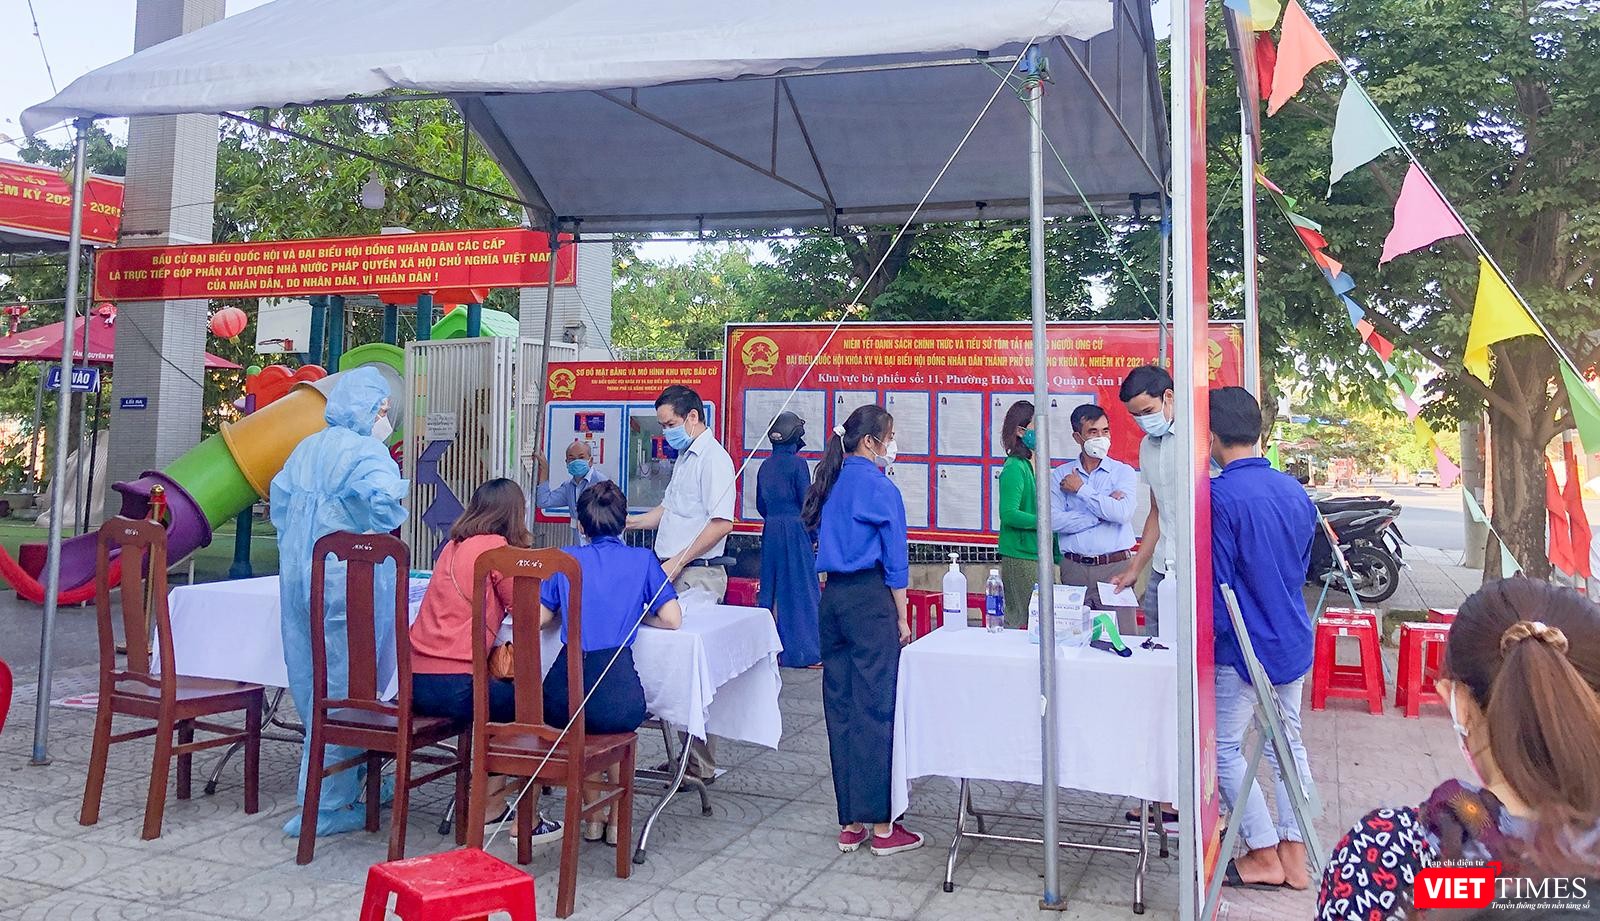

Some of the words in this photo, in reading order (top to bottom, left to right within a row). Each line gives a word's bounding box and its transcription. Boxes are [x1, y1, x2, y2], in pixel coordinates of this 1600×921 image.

[45, 192, 72, 206] 202
[152, 252, 171, 266] BẦU
[174, 251, 188, 264] CỬ
[190, 251, 207, 265] ĐẠI
[209, 250, 231, 263] BIỂU
[234, 249, 260, 263] QUỐC
[263, 249, 280, 263] HỘI
[282, 248, 295, 260] VÀ
[298, 247, 316, 261] ĐẠI
[319, 245, 342, 258] BIỂU
[345, 244, 362, 258] HỘI
[365, 242, 394, 256] ĐỒNG
[398, 240, 428, 254] NHÂN
[431, 240, 455, 252] DÂN
[457, 239, 480, 251] CÁC
[483, 238, 505, 250] CẤP
[110, 269, 121, 281] LÀ
[124, 268, 147, 281] TRỰC
[150, 266, 171, 279] TIẾP
[173, 266, 192, 279] GÓP
[195, 265, 222, 278] PHẦN
[225, 264, 243, 276] XÂY
[247, 263, 273, 277] DỰNG
[277, 262, 297, 274] NHÀ
[300, 261, 328, 273] NƯỚC
[332, 260, 359, 272] PHÁP
[362, 257, 397, 271] QUYỀN
[400, 256, 414, 269] XÃ
[417, 256, 436, 269] HỘI
[439, 254, 461, 267] CHỦ
[464, 253, 499, 265] NGHĨA
[502, 252, 526, 265] VIỆT
[207, 278, 226, 291] CỦA
[229, 277, 256, 290] NHÂN
[259, 276, 284, 290] DÂN,
[286, 276, 300, 288] DO
[303, 275, 332, 287] NHÂN
[335, 273, 360, 286] DÂN,
[362, 272, 372, 284] VÌ
[376, 272, 405, 284] NHÂN
[408, 271, 431, 283] DÂN
[434, 271, 439, 282] !
[1024, 339, 1049, 350] NHG
[72, 370, 90, 385] VÀO
[818, 373, 839, 383] Khu
[842, 374, 858, 385] vực
[862, 373, 874, 383] bỏ
[877, 371, 906, 385] phiếu
[909, 371, 924, 384] số:
[928, 375, 943, 385] 11,
[946, 374, 988, 386] Phường
[992, 375, 1014, 385] Hòa
[1053, 376, 1084, 389] Quận
